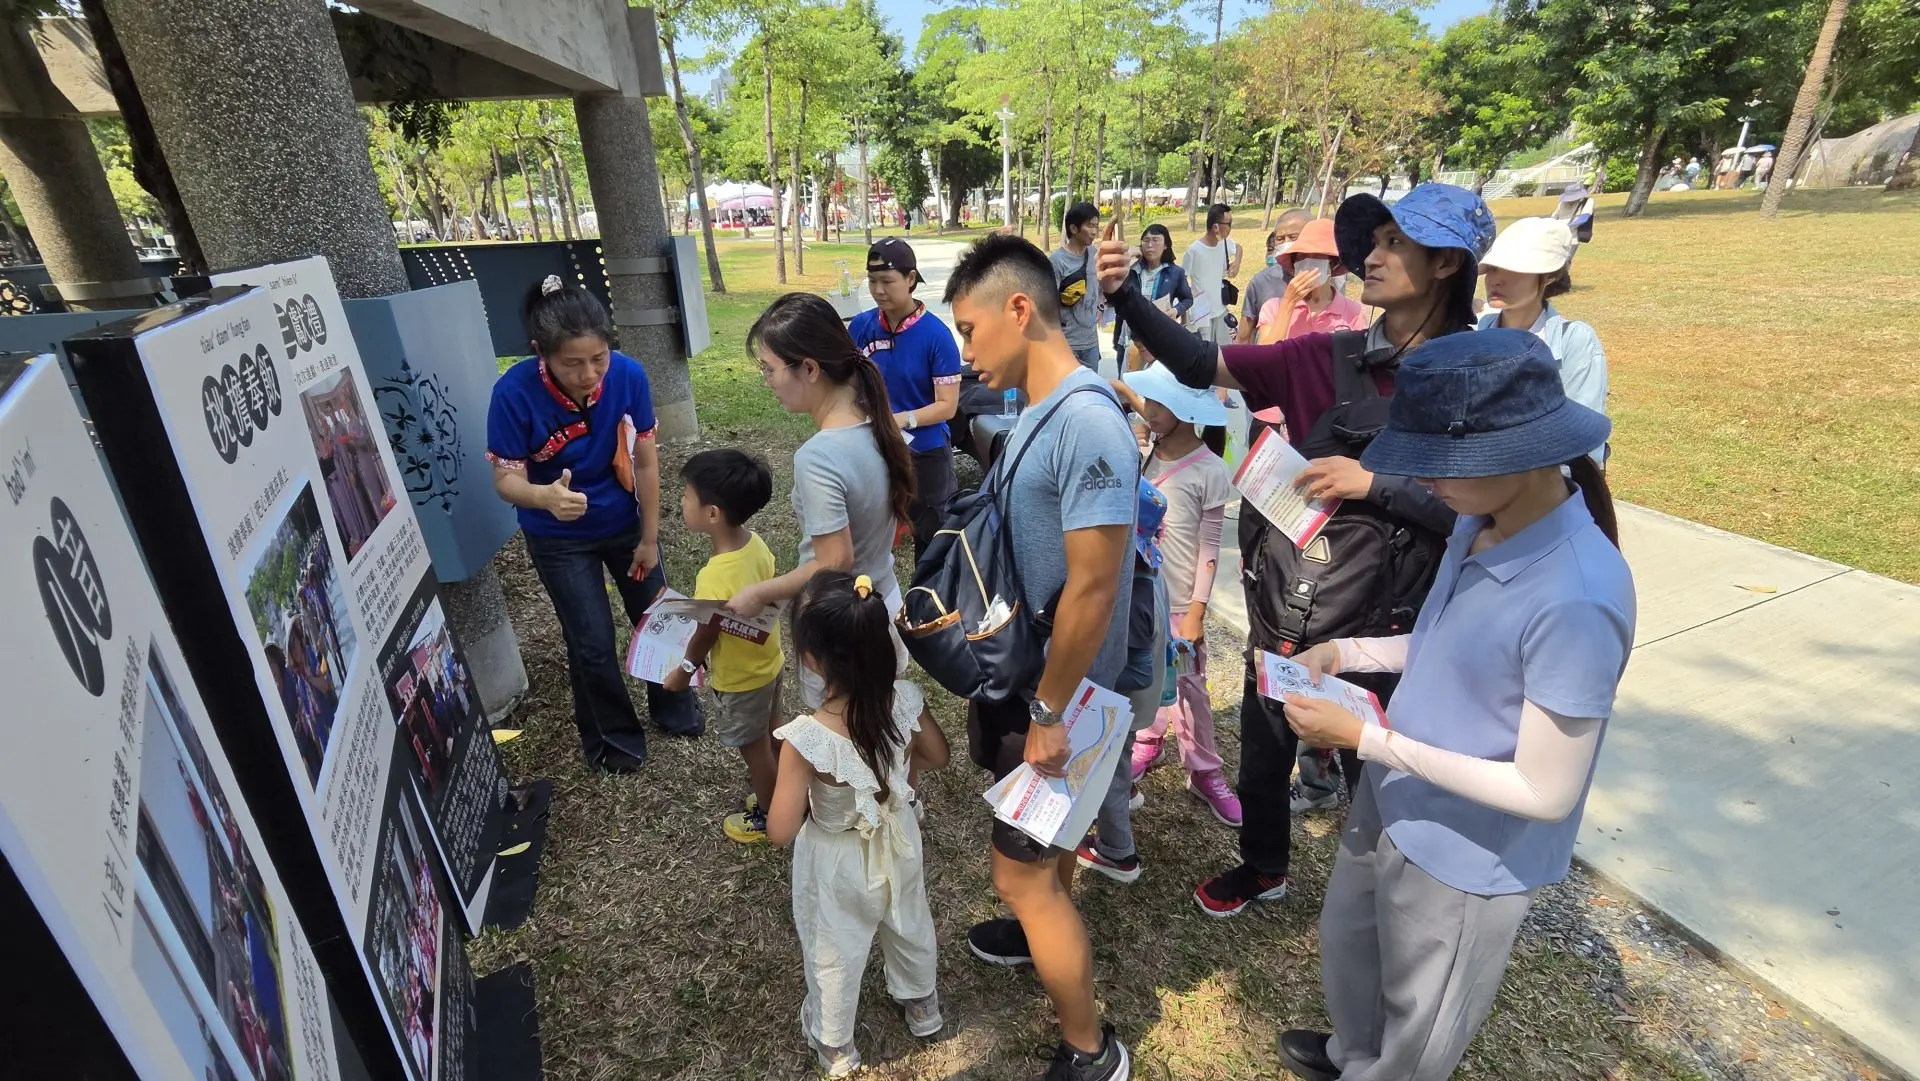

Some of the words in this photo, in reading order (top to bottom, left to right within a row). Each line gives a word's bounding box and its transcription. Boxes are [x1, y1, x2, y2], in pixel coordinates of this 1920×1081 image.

[277, 299, 325, 346] 三獻禮
[204, 353, 282, 454] 挑擔奉飯
[1076, 477, 1122, 493] adidas
[45, 516, 105, 691] 八音
